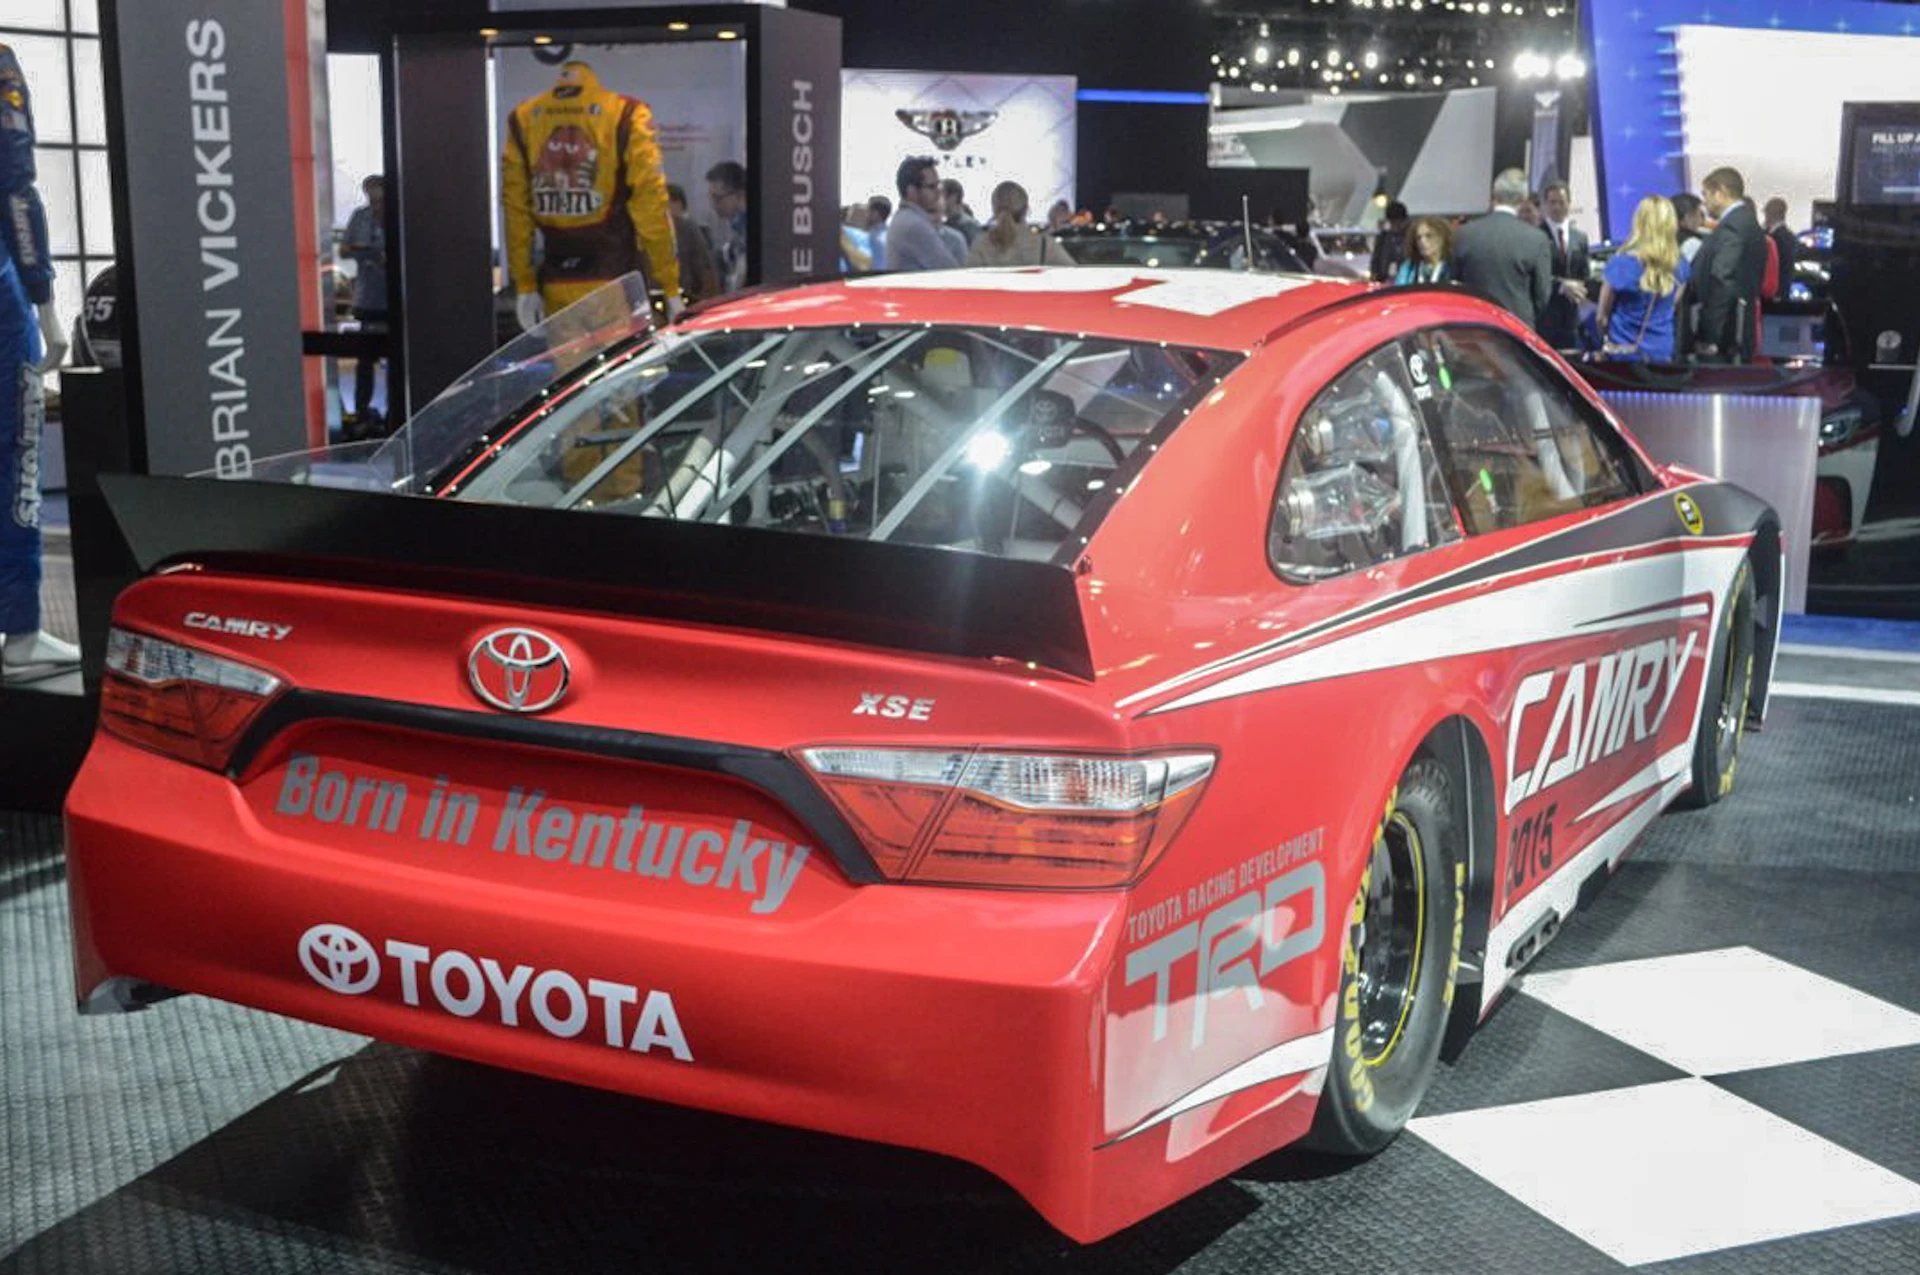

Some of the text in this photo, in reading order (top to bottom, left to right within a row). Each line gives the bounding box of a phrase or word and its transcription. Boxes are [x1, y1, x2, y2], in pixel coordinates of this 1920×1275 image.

[792, 80, 813, 234] BUSCH
[185, 19, 252, 480] BRIAN VICKERS
[183, 611, 293, 641] CAMRY
[852, 692, 936, 721] XSE
[1504, 630, 1698, 815] CAMRY
[277, 752, 811, 914] Born in Kentucky
[1129, 827, 1325, 943] TOYOTA RACING DEVELOPMENT
[385, 939, 694, 1063] TOYOTA
[1125, 859, 1325, 1049] TRD
